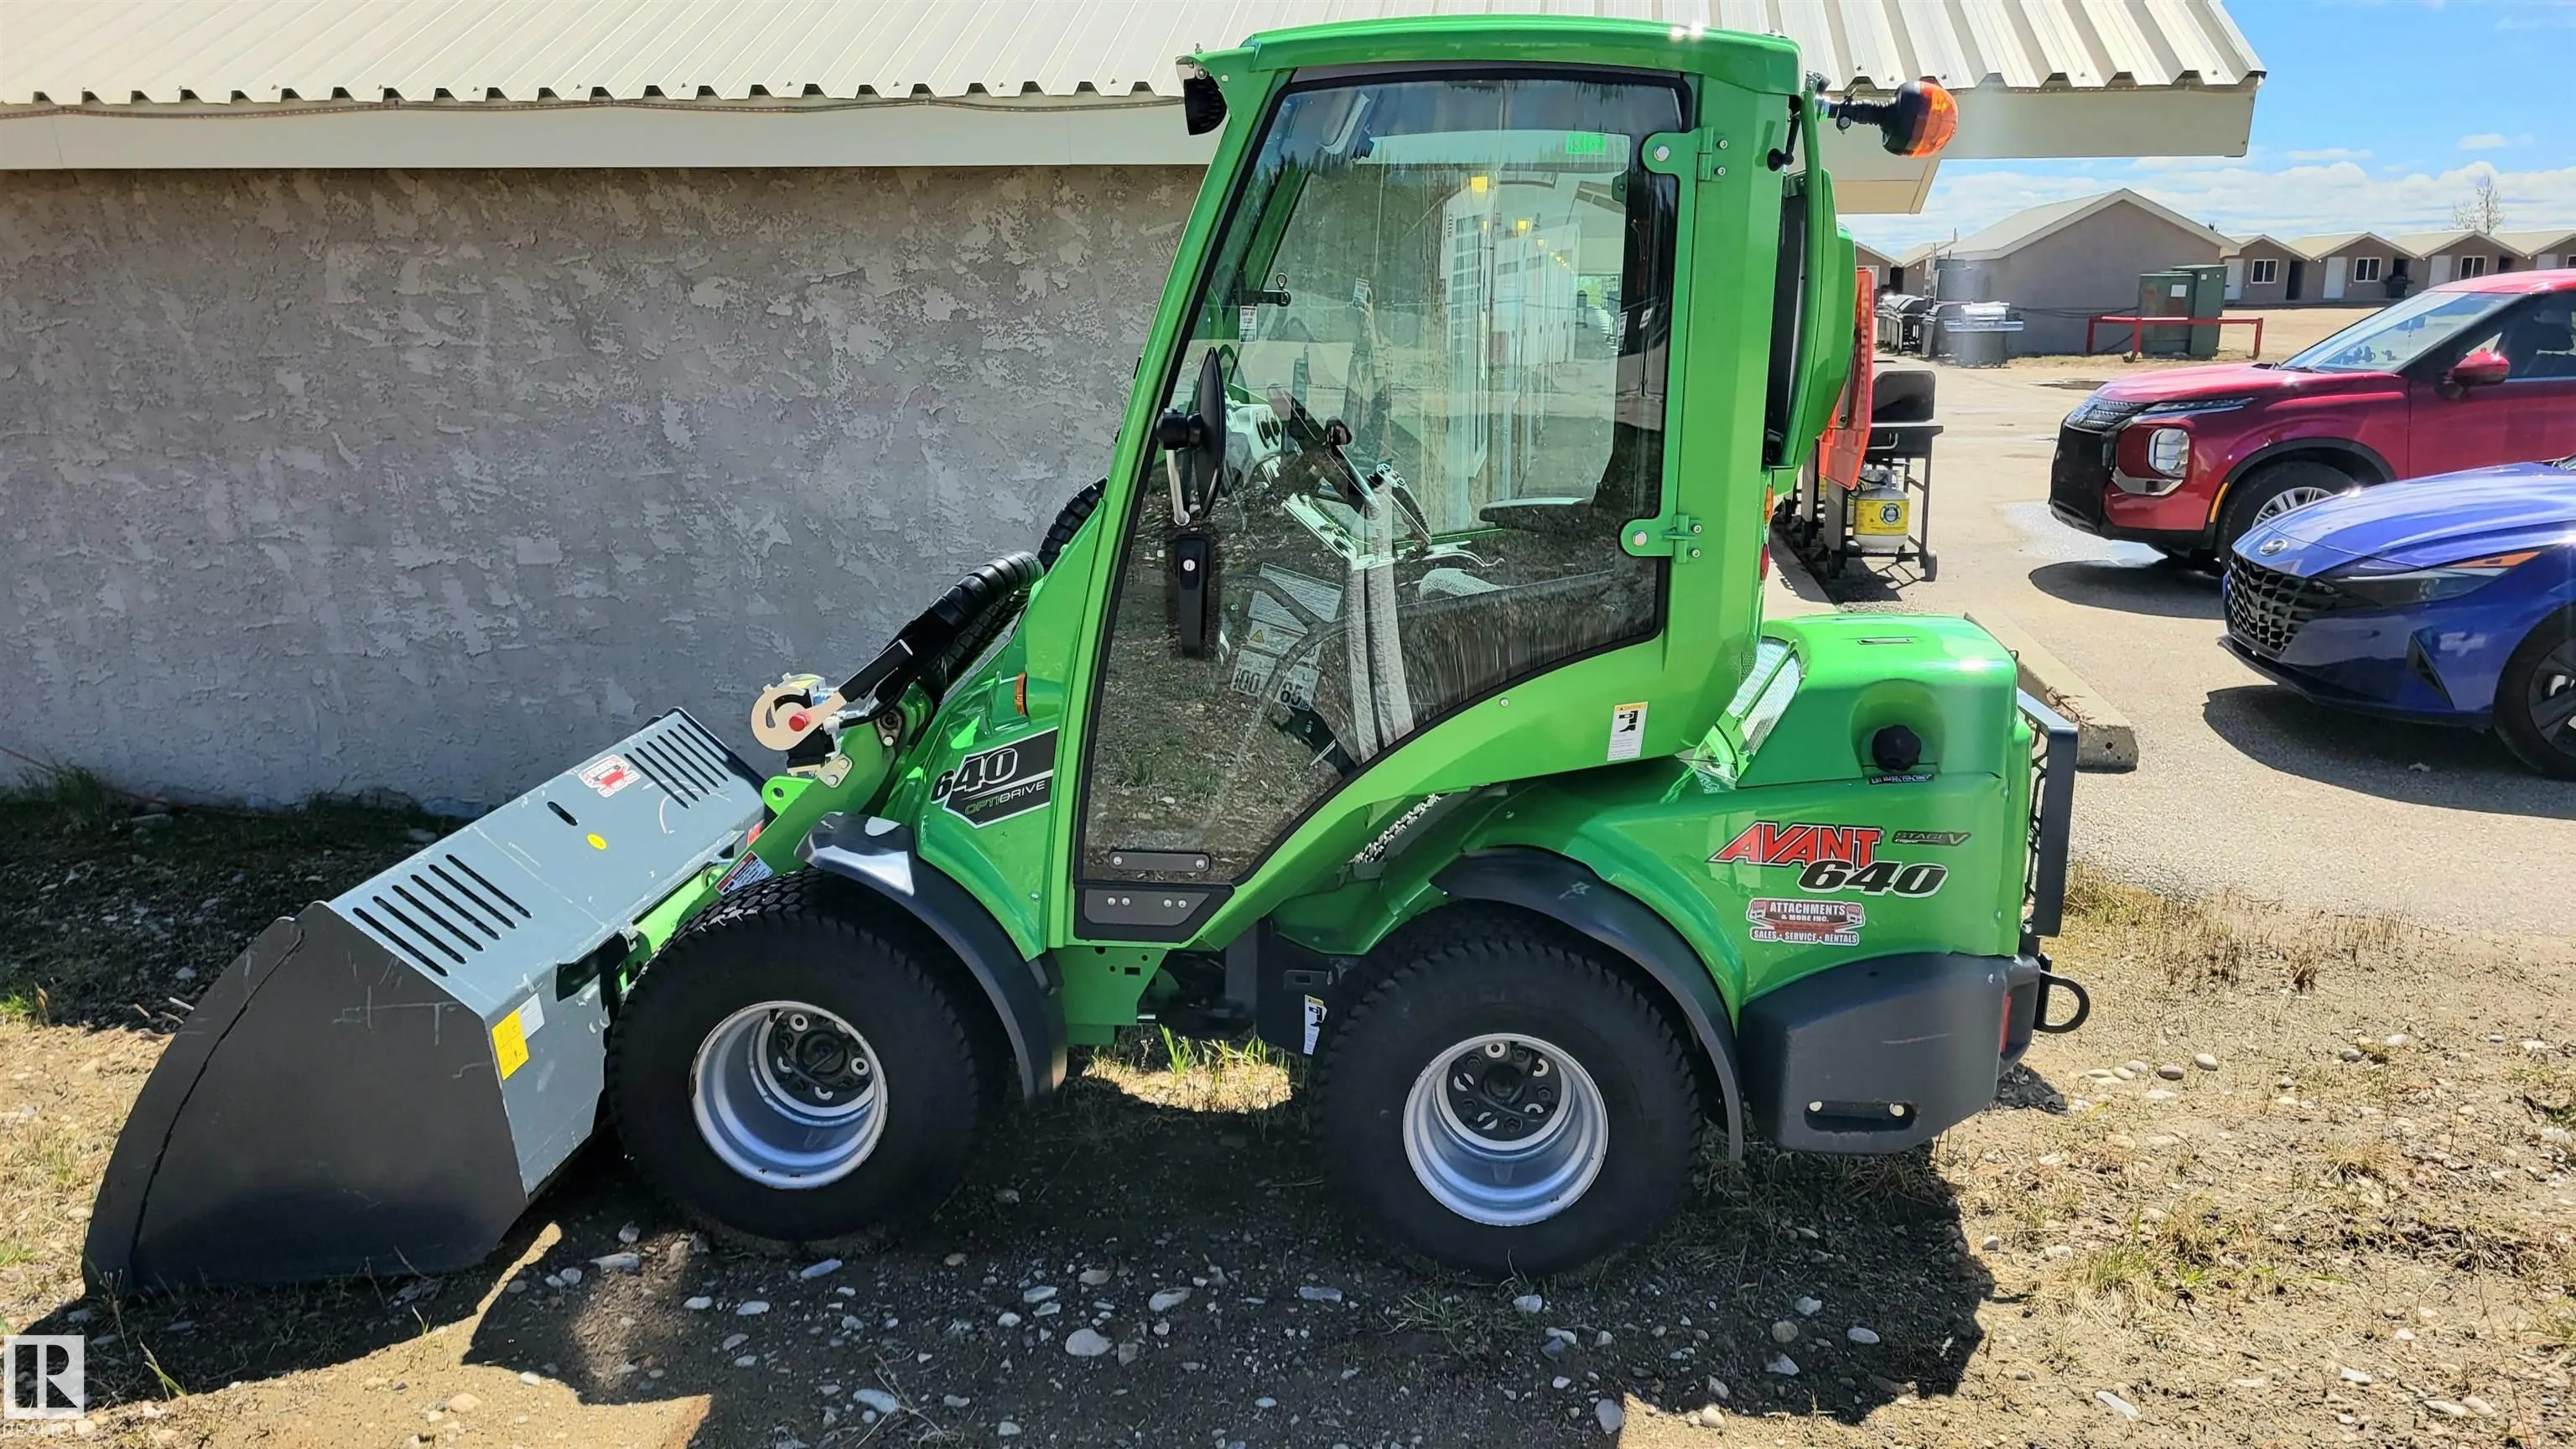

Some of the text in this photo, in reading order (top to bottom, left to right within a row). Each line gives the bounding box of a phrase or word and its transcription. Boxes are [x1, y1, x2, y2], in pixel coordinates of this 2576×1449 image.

[929, 747, 1018, 804] 640
[964, 780, 1046, 814] OPTIDRIVE
[1711, 822, 1881, 870] AVANT
[1797, 859, 1949, 898] 640
[1769, 901, 1846, 916] ATTACHMENTS
[1753, 929, 1857, 943] SALES SERVICE RENTALS
